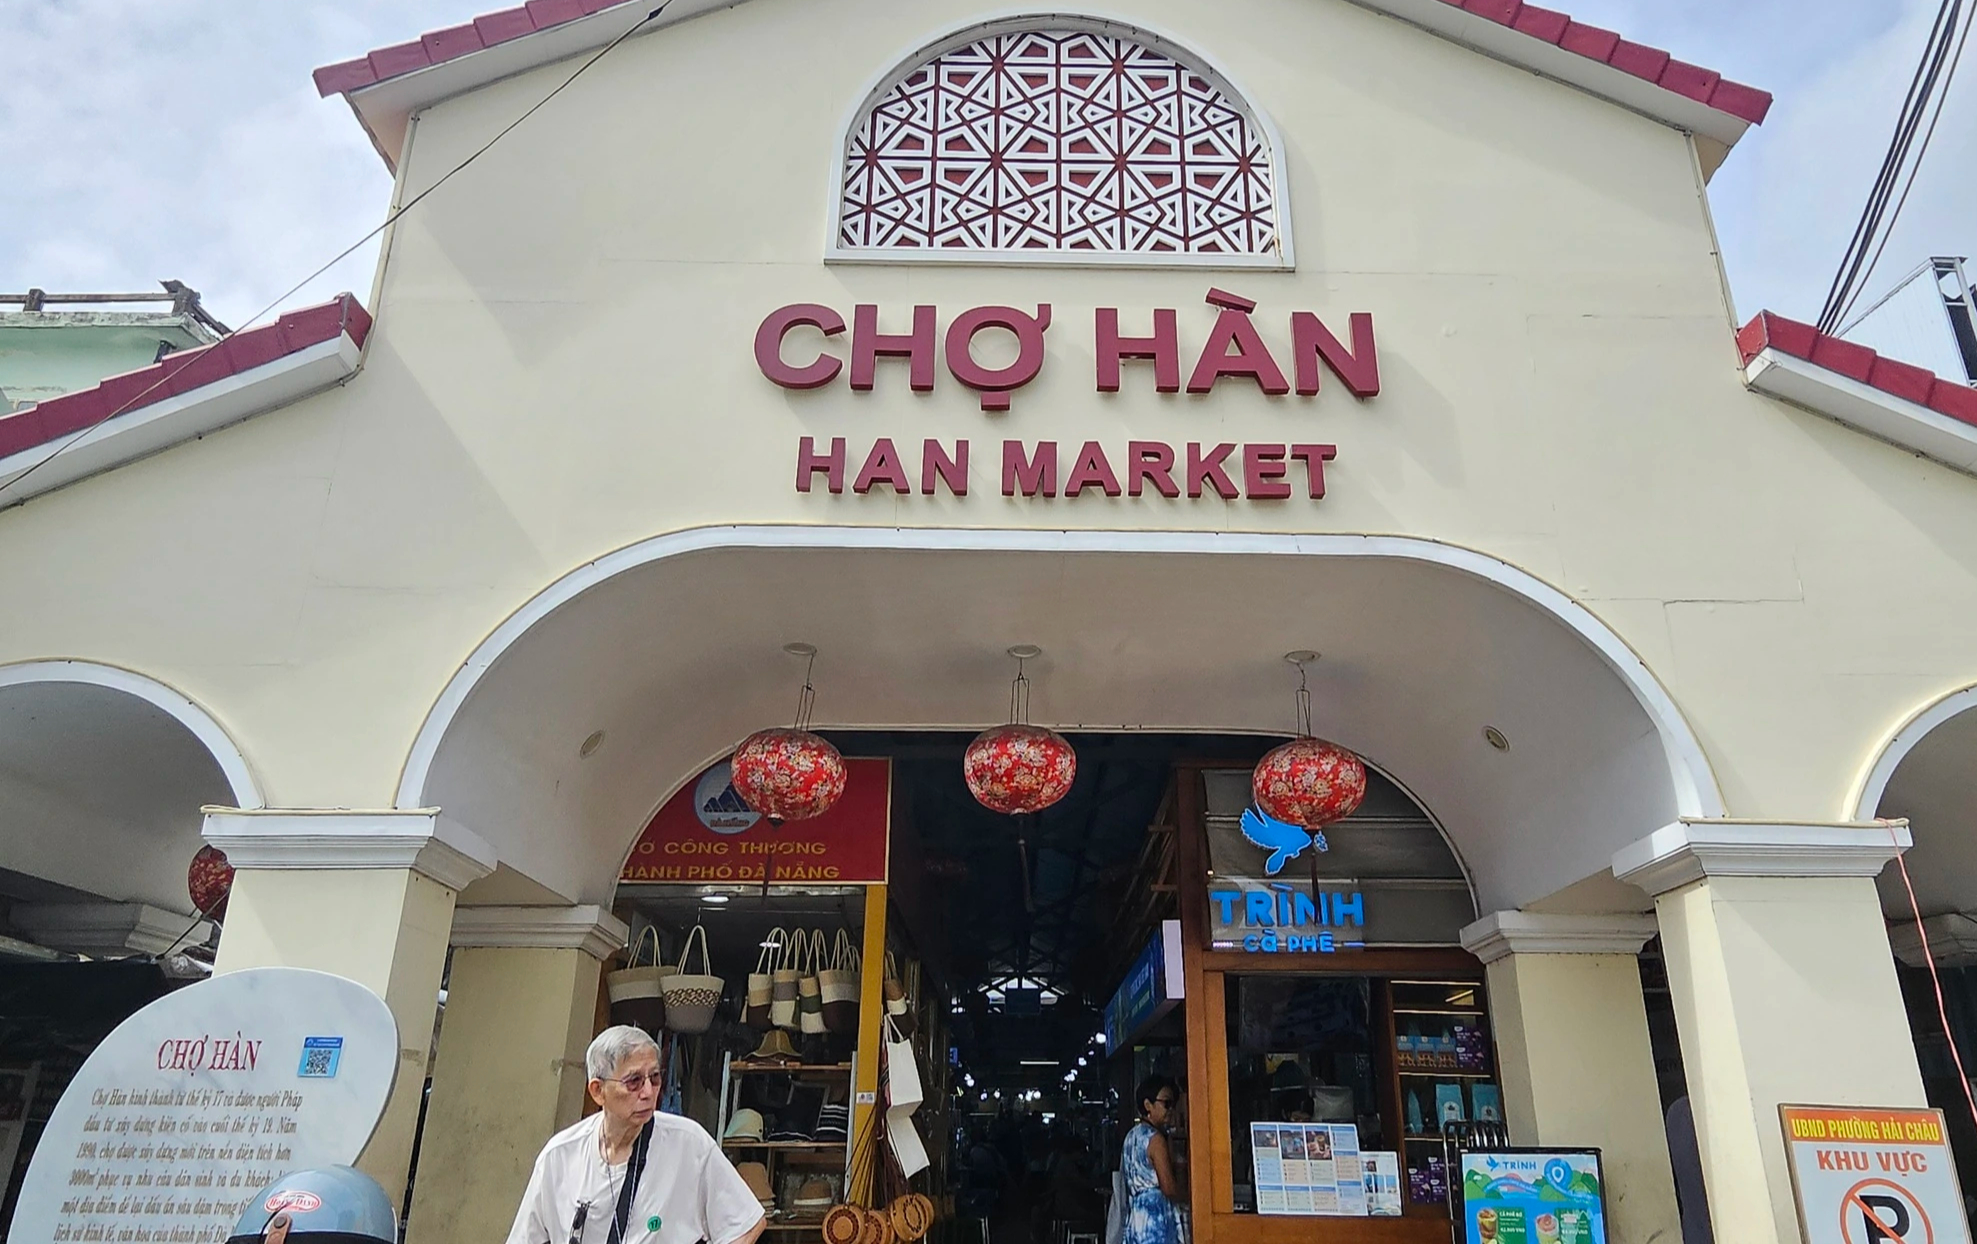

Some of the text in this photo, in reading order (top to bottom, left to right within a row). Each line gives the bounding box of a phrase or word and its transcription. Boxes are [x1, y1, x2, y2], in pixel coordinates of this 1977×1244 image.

[754, 286, 1381, 411] CHỢ HÀN
[795, 436, 1337, 499] HAN MARKET
[663, 838, 730, 855] CÔNG
[739, 840, 827, 855] THƯƠNG
[622, 860, 840, 879] HÀNH PHỐ ĐÀ NẴNG
[1210, 882, 1365, 927] TRÌNH
[1287, 931, 1336, 953] PHÊ
[157, 1030, 262, 1076] CHỢ HÀN
[1791, 1116, 1940, 1142] UBND PHƯỜNG HẢI CHÂU
[1816, 1149, 1928, 1177] KHU VỰC
